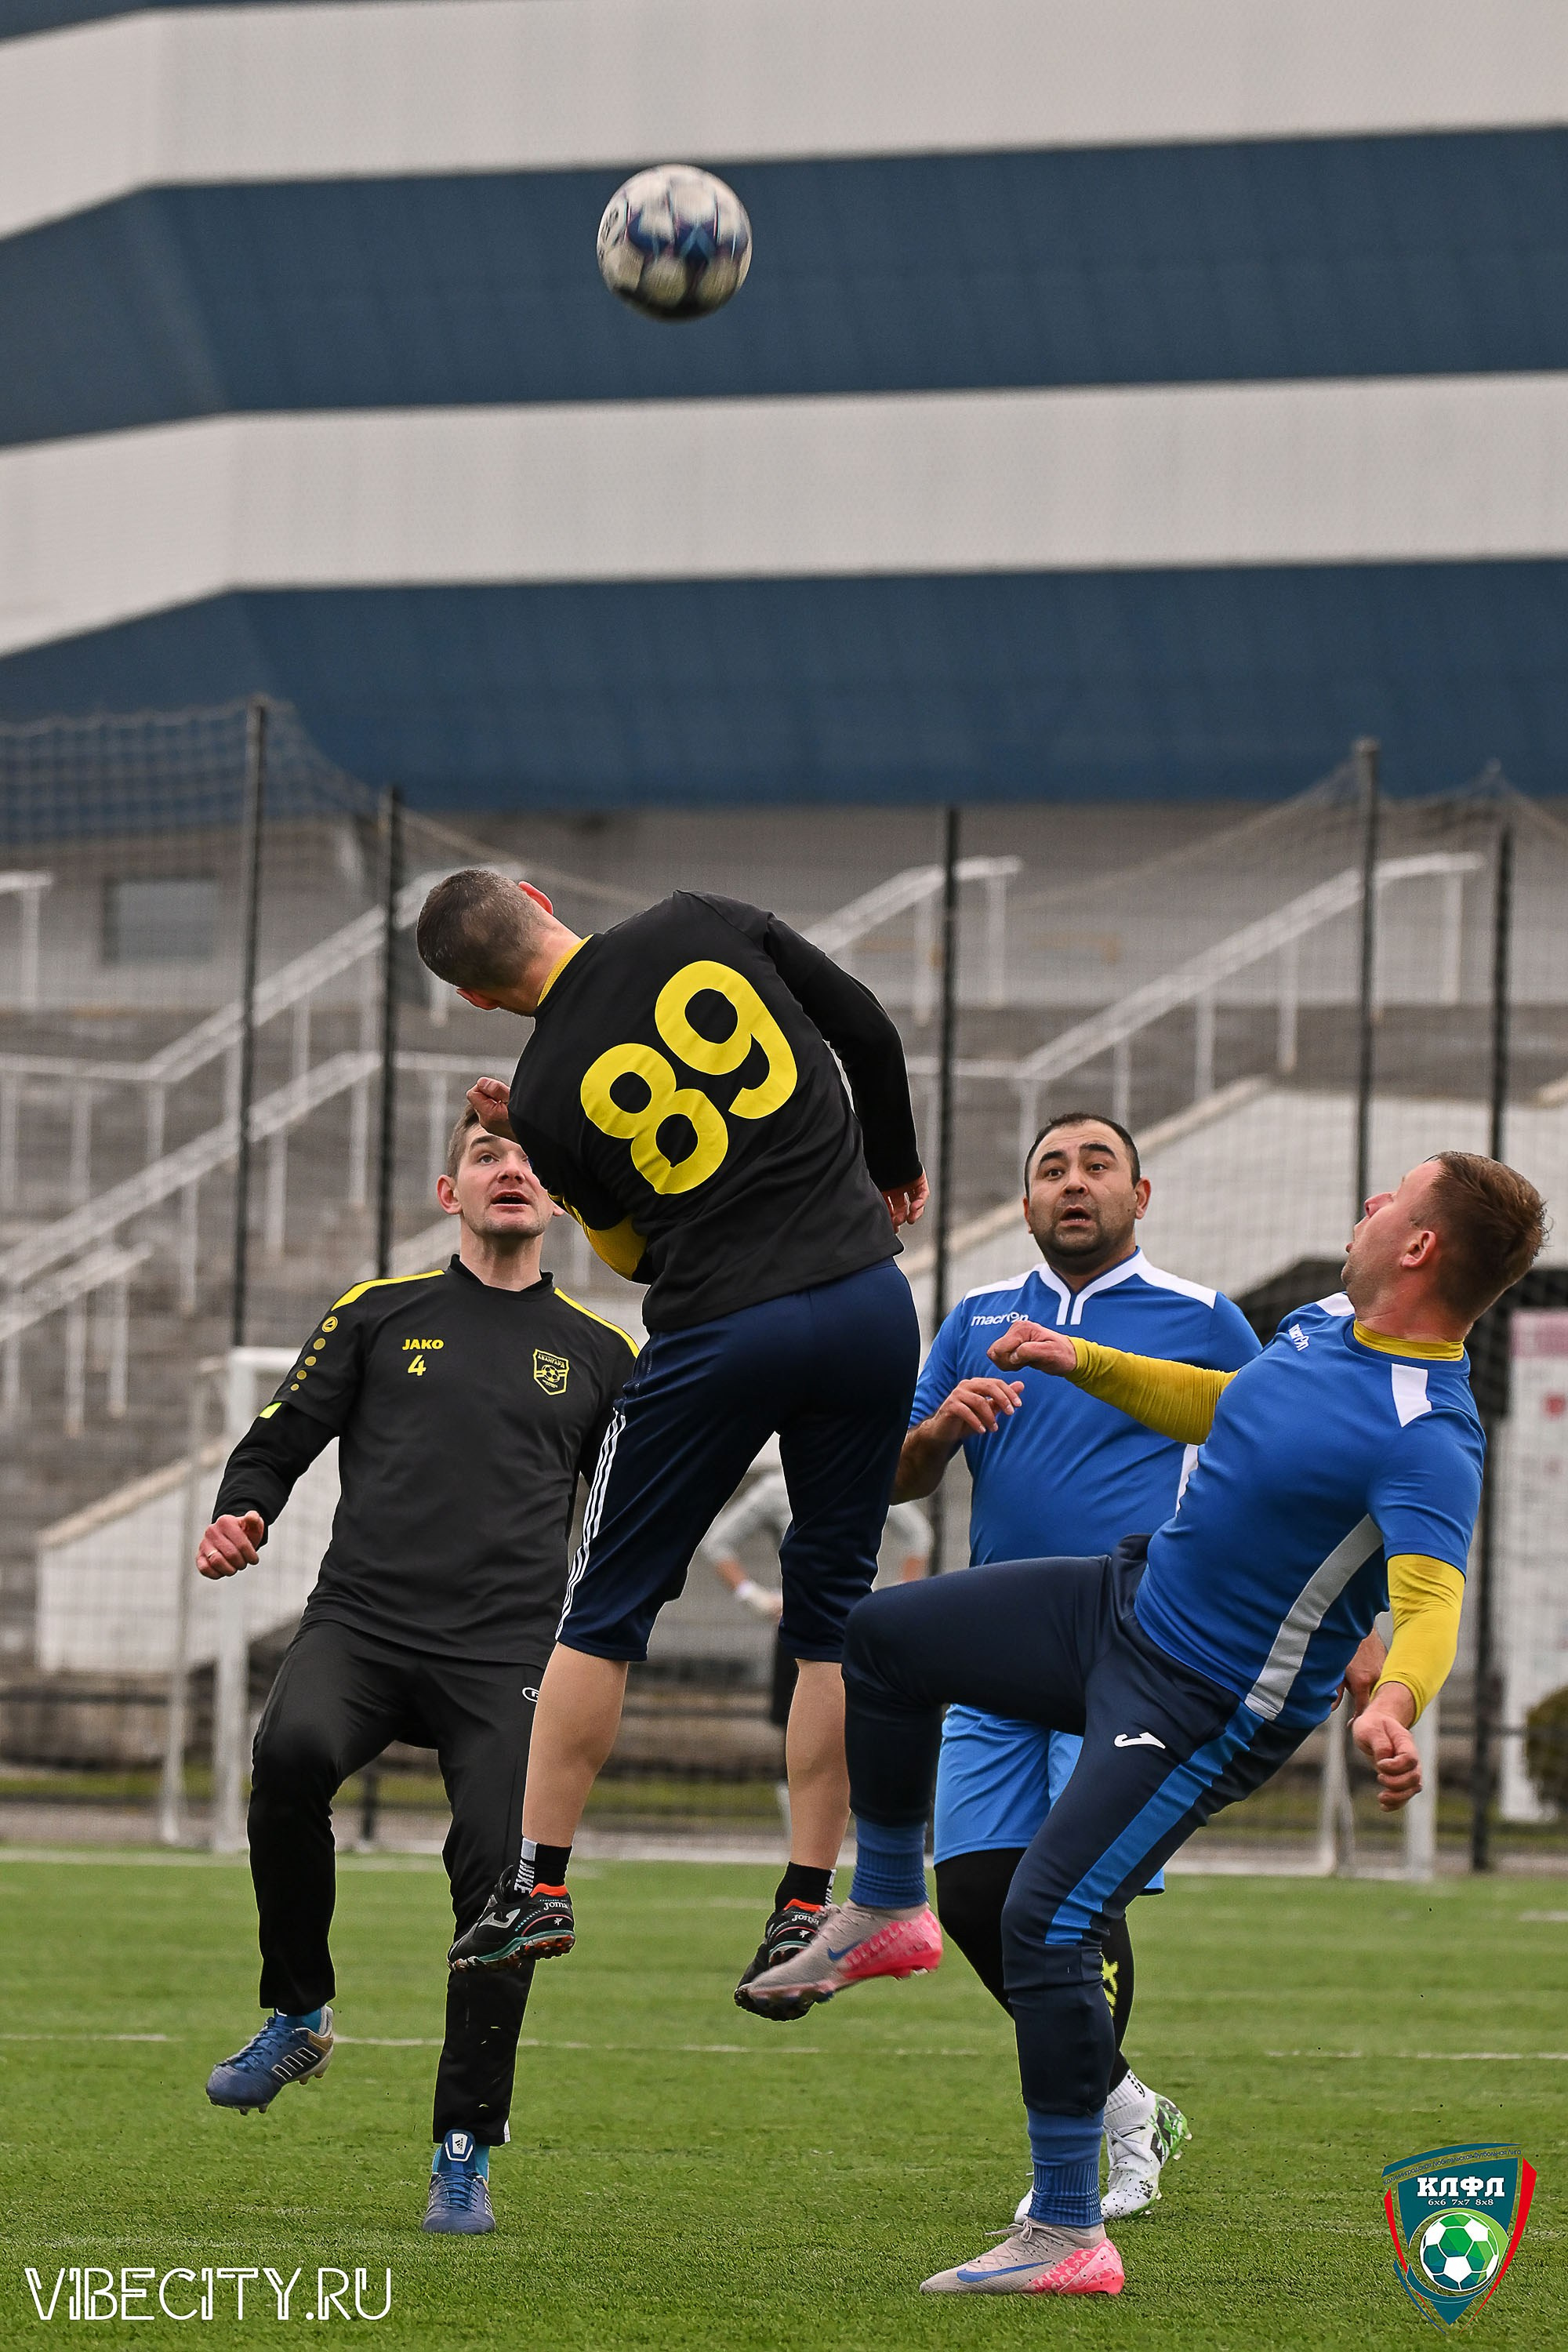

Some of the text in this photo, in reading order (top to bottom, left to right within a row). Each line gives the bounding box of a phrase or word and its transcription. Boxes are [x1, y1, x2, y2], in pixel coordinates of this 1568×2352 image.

[579, 960, 798, 1195] 89
[971, 1312, 1029, 1327] macron
[402, 1339, 445, 1351] JAKO
[408, 1355, 426, 1376] 4
